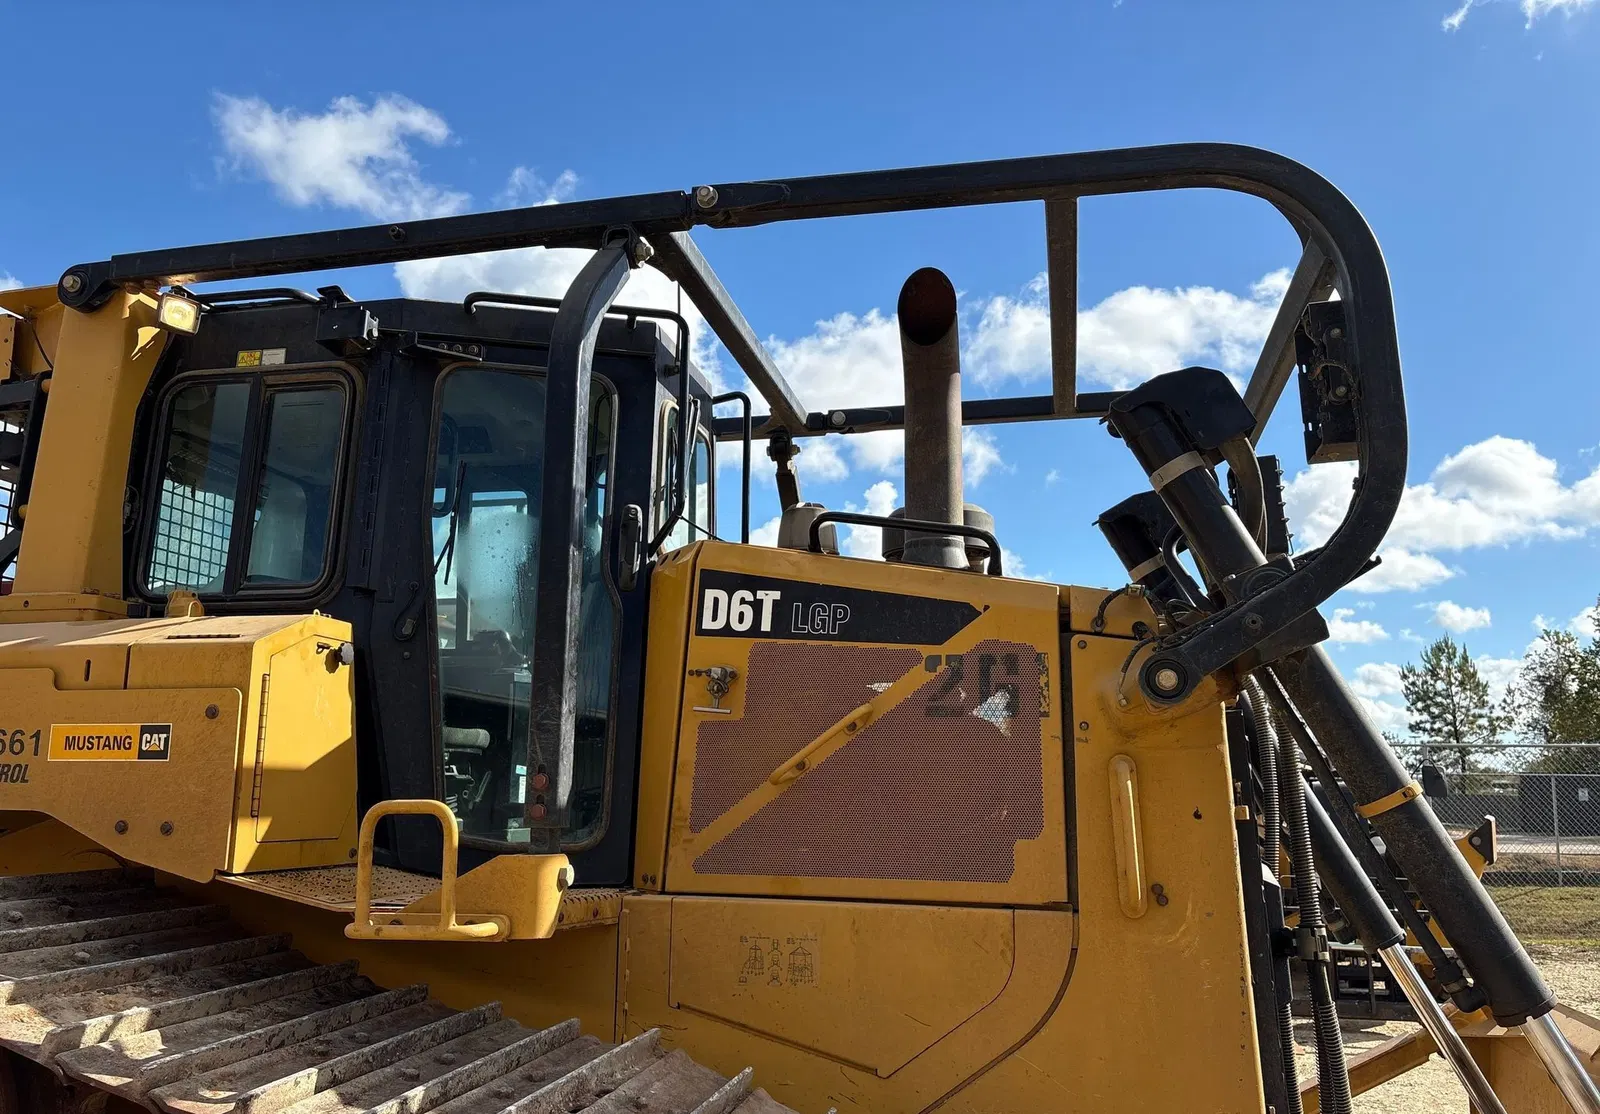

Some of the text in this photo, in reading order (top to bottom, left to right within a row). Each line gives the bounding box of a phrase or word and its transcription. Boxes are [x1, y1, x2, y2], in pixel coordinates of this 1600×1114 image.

[701, 588, 851, 635] D6T LGP
[64, 733, 168, 751] MUSTANG CAT
[0, 763, 30, 784] ROL
